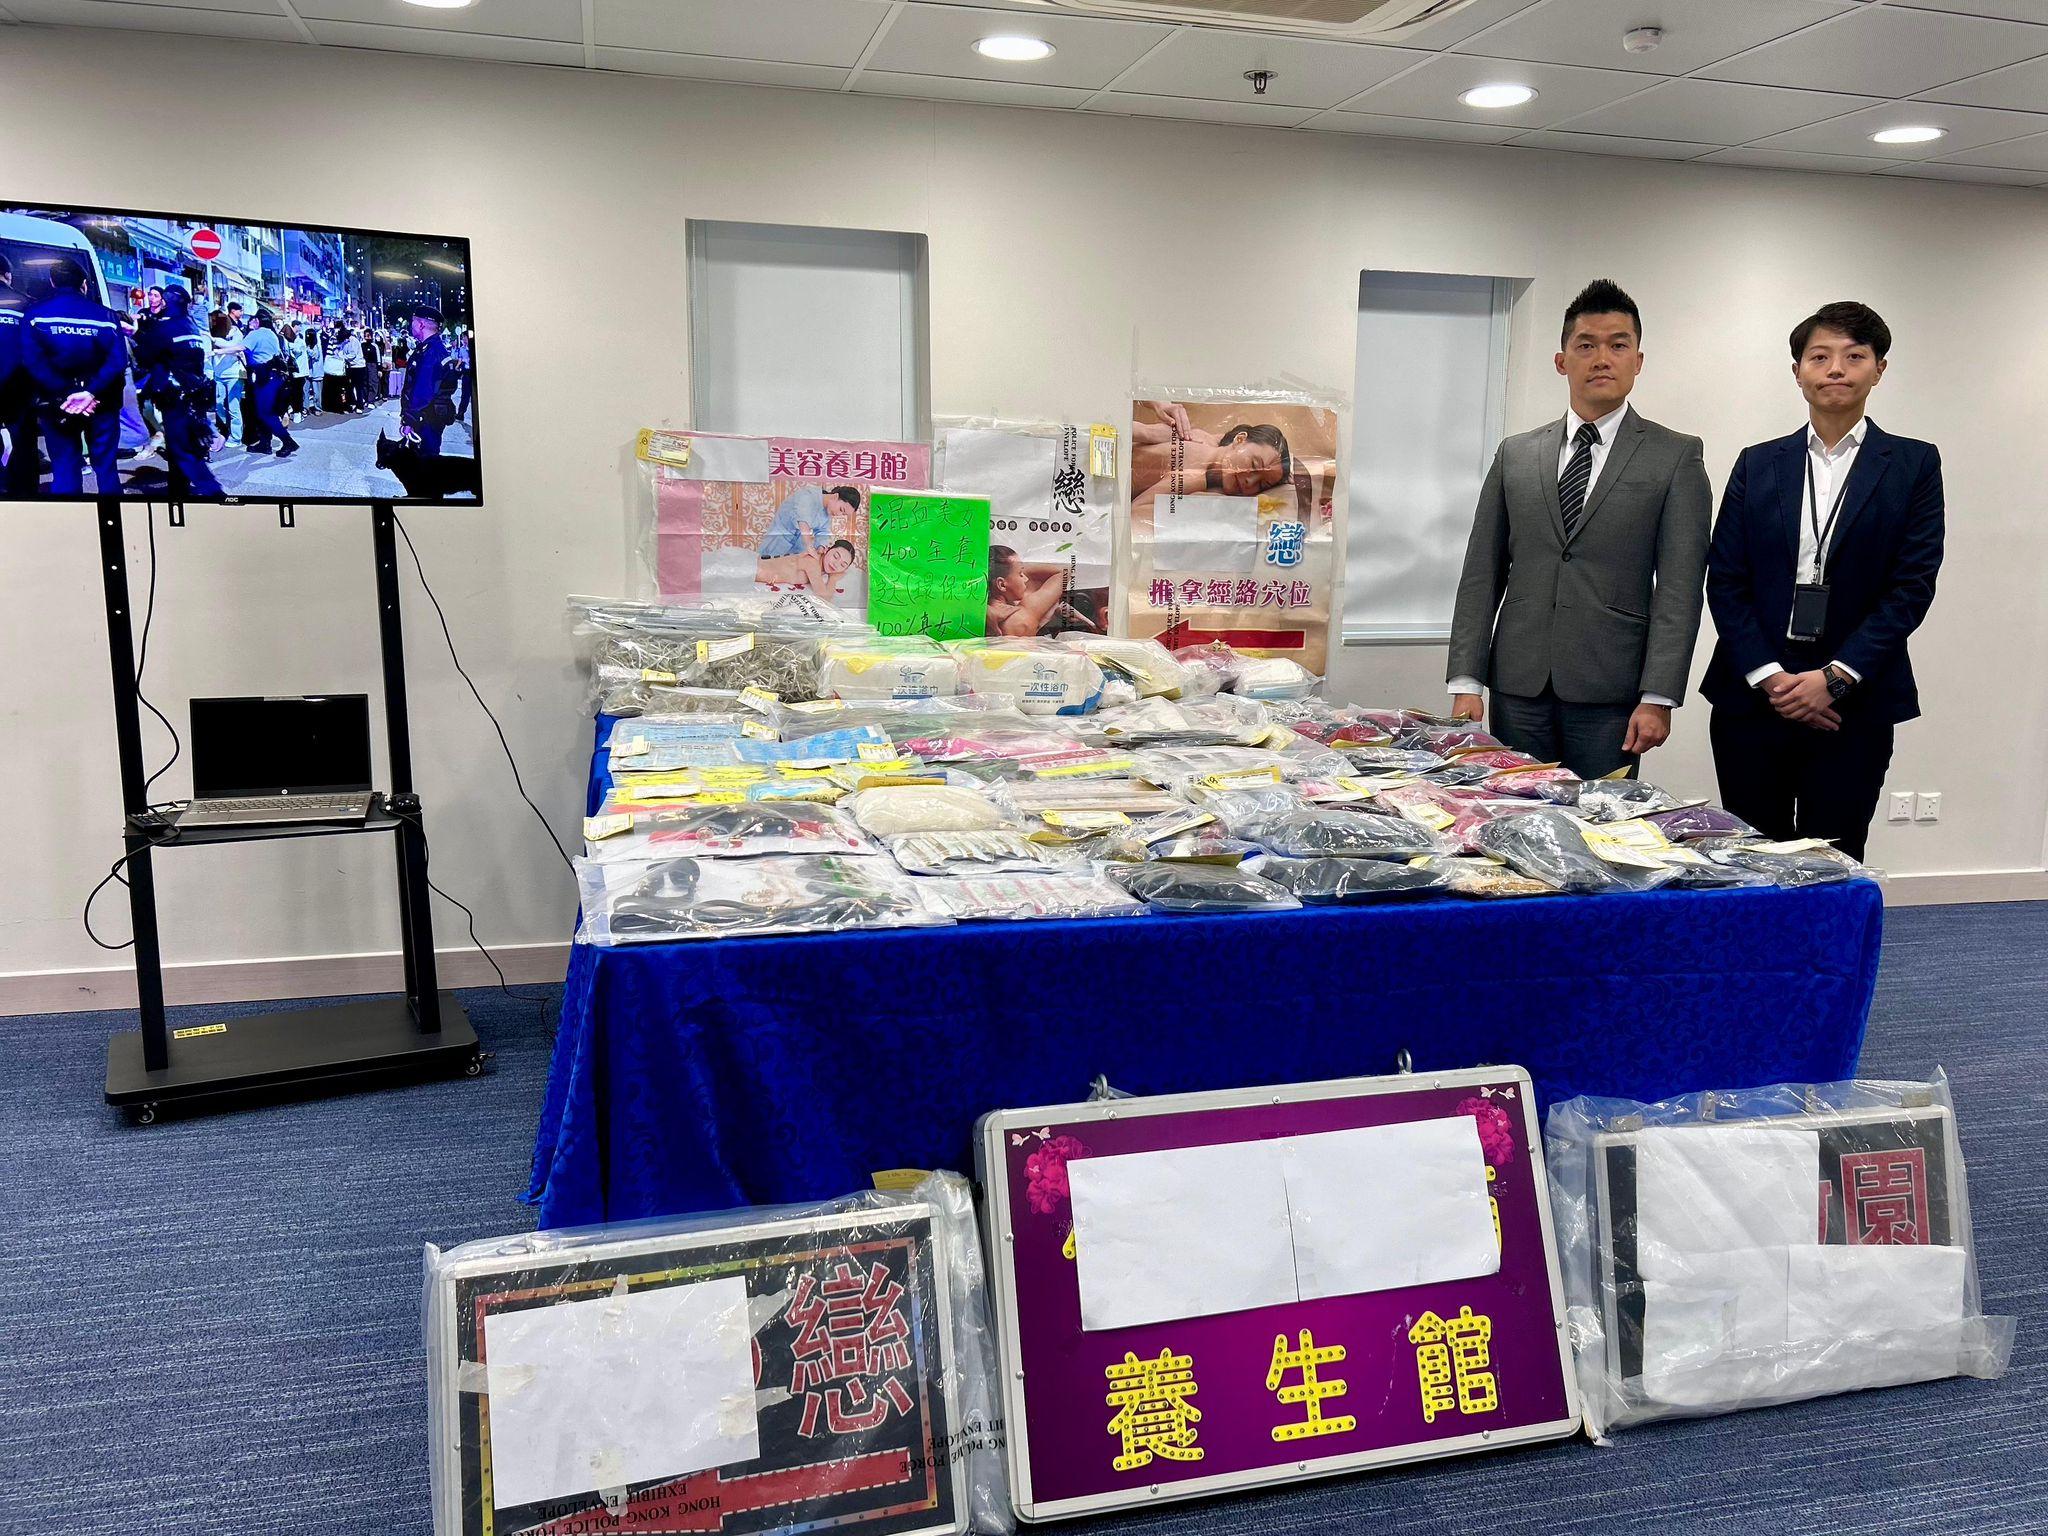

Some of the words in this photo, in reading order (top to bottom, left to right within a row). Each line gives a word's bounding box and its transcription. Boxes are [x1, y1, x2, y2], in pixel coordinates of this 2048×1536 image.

[58, 326, 92, 336] POLICE
[769, 447, 907, 480] 美容養身館
[876, 497, 974, 531] 混血美女
[881, 541, 918, 562] 400
[1267, 523, 1305, 566] 戀
[1149, 578, 1311, 607] 推拿經絡穴位
[1020, 682, 1069, 693] 一次性浴巾
[1819, 1147, 1931, 1245] 園
[784, 1261, 915, 1439] 戀
[1105, 1305, 1499, 1472] 養生館
[988, 1437, 1006, 1450] NG
[899, 1454, 946, 1473] FORCE
[626, 1482, 688, 1505] EXHIBIT
[537, 1494, 620, 1520] ENVELOPE
[626, 1507, 671, 1525] KONG
[678, 1496, 721, 1516] HONG
[563, 1514, 620, 1536] POLICE
